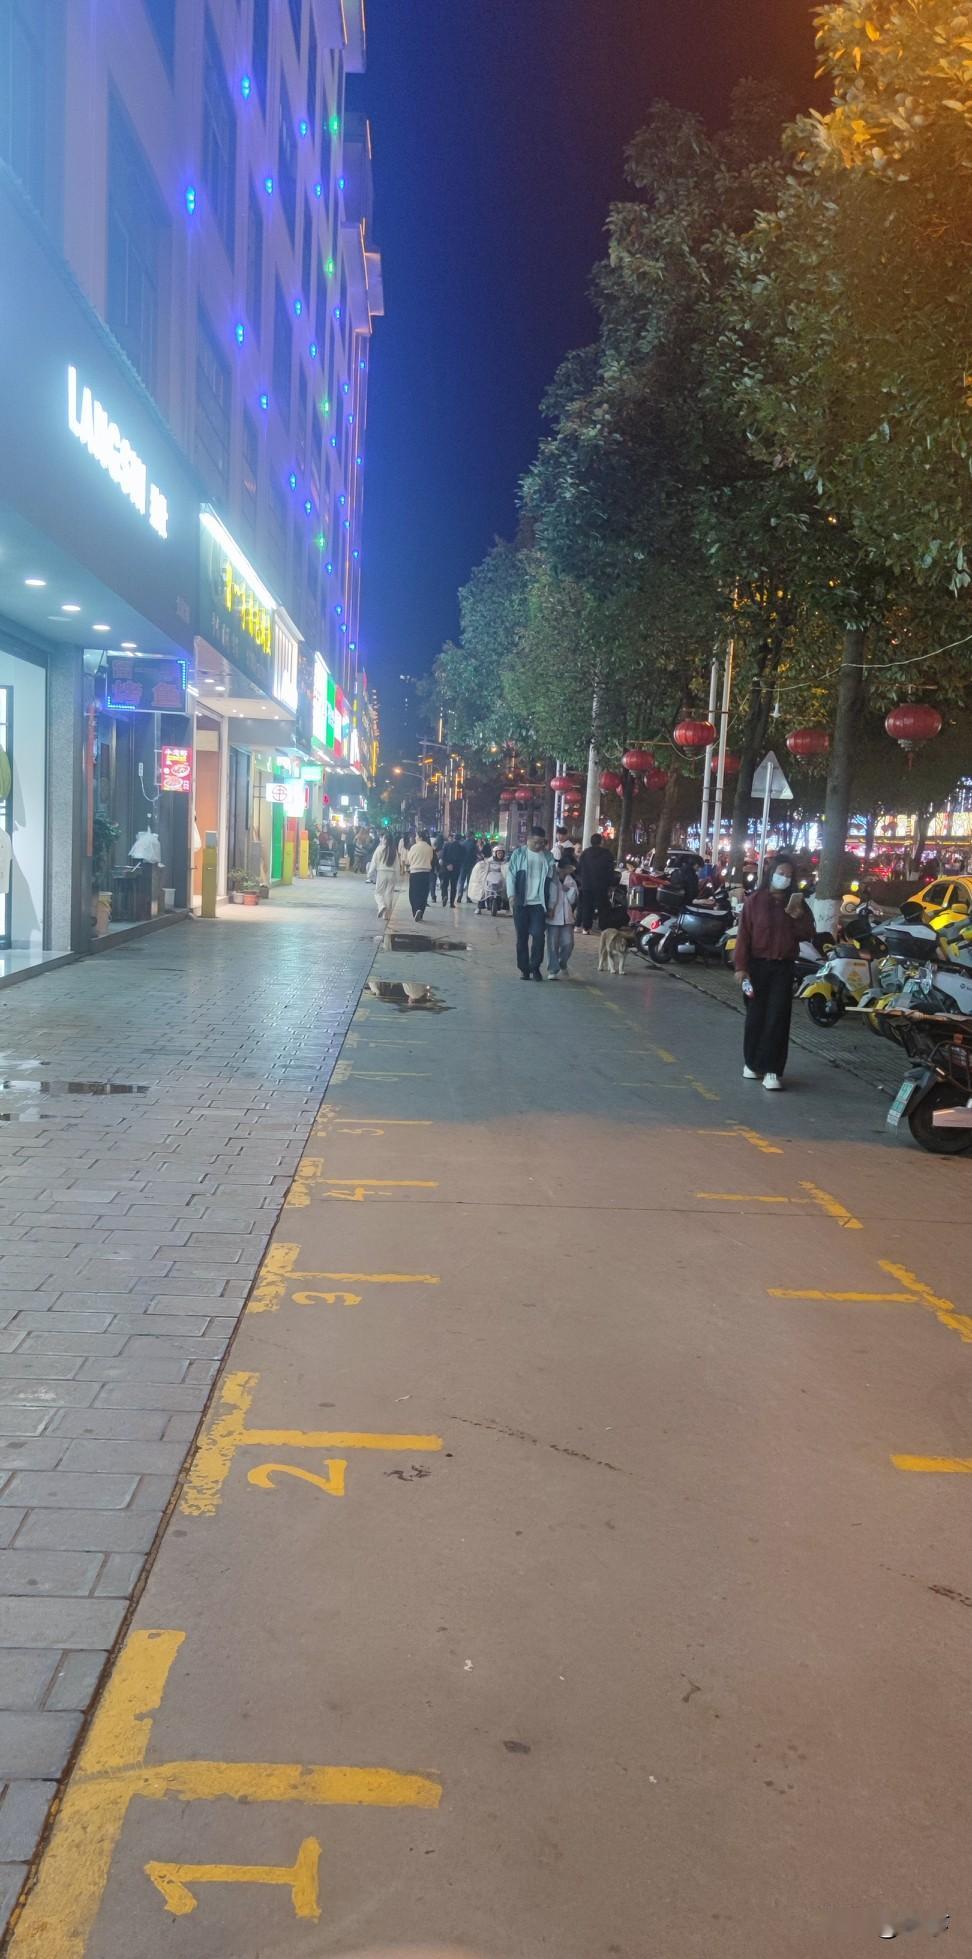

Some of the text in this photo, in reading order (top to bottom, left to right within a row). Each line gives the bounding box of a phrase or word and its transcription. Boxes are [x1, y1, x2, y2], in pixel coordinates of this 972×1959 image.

[336, 1127, 385, 1137] 5
[323, 1187, 393, 1202] 4
[291, 1291, 362, 1306] 3
[248, 1457, 349, 1498] 2
[145, 1837, 321, 1921] 1
